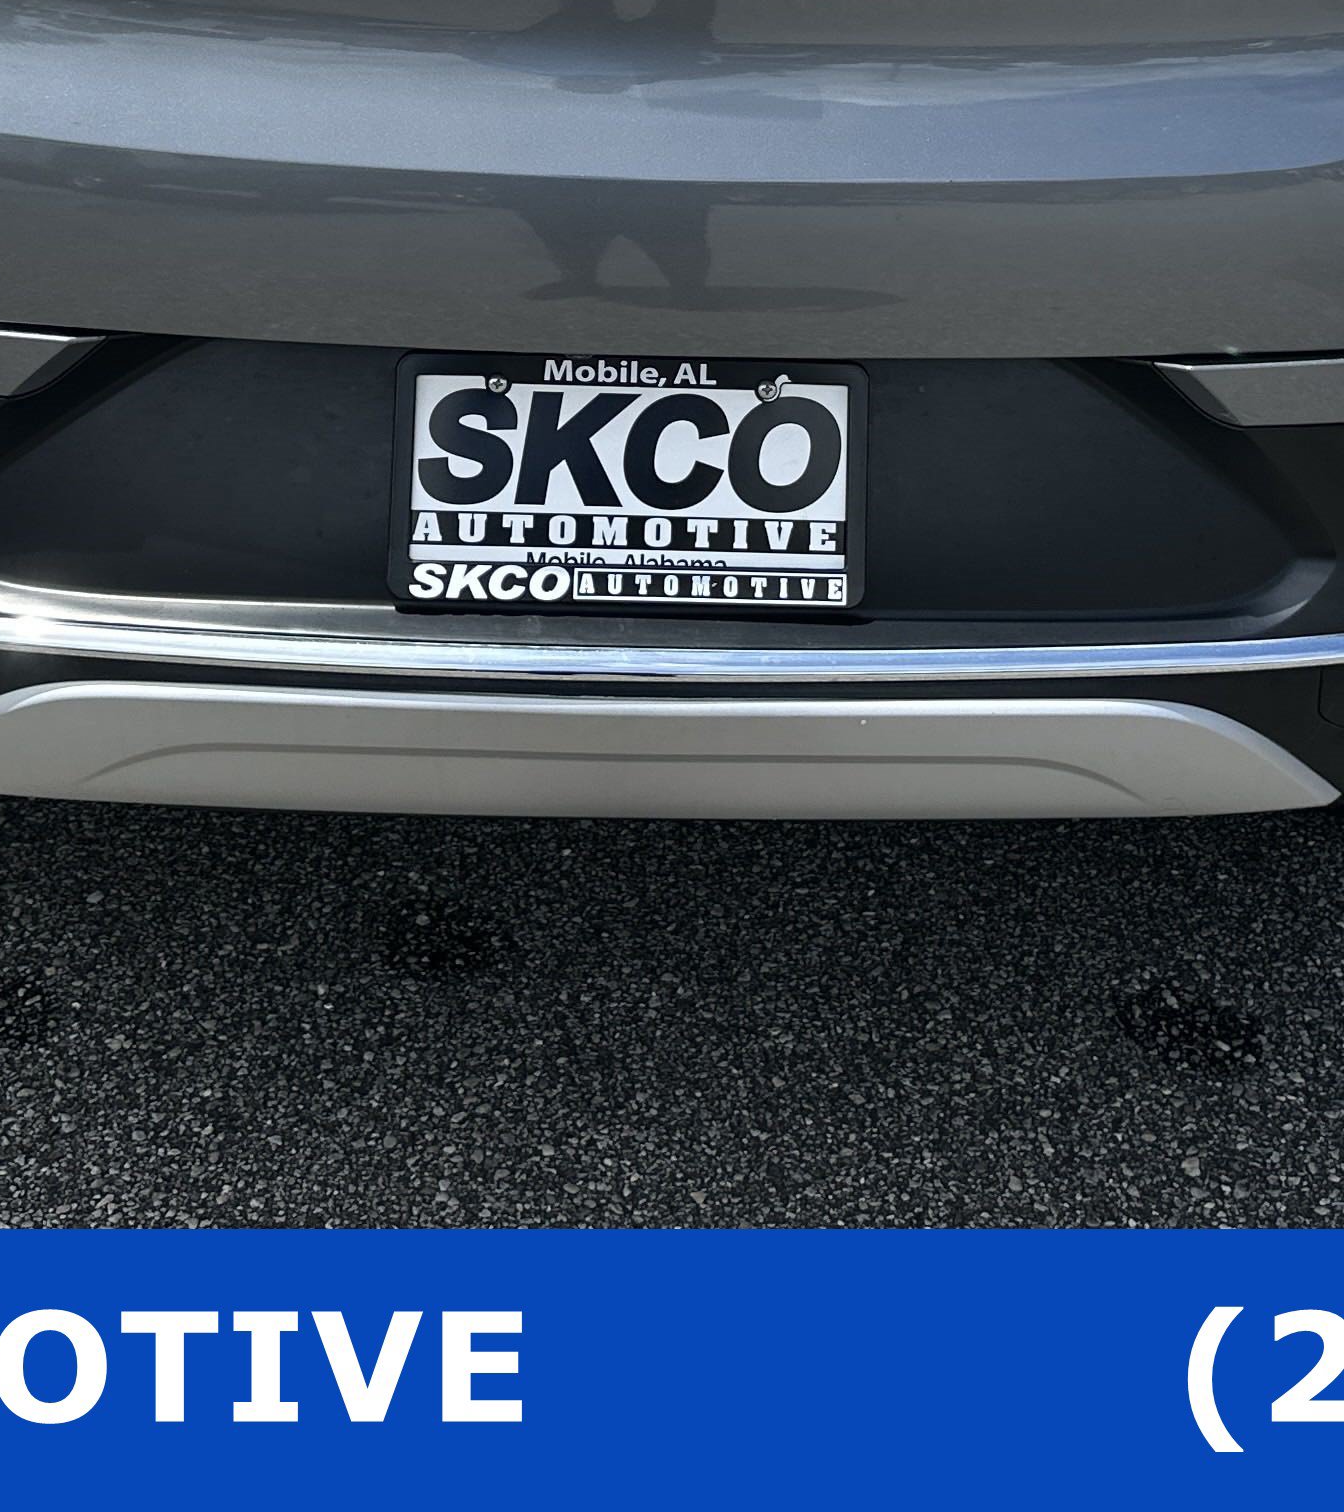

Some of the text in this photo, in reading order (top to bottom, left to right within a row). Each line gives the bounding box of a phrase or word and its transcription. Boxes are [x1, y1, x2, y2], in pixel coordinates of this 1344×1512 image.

[543, 359, 717, 387] Mobile, AL
[418, 388, 842, 514] SKCO
[412, 511, 838, 552] AUTOMOTIVE
[408, 564, 844, 601] SKCO AUTOMOTIVE
